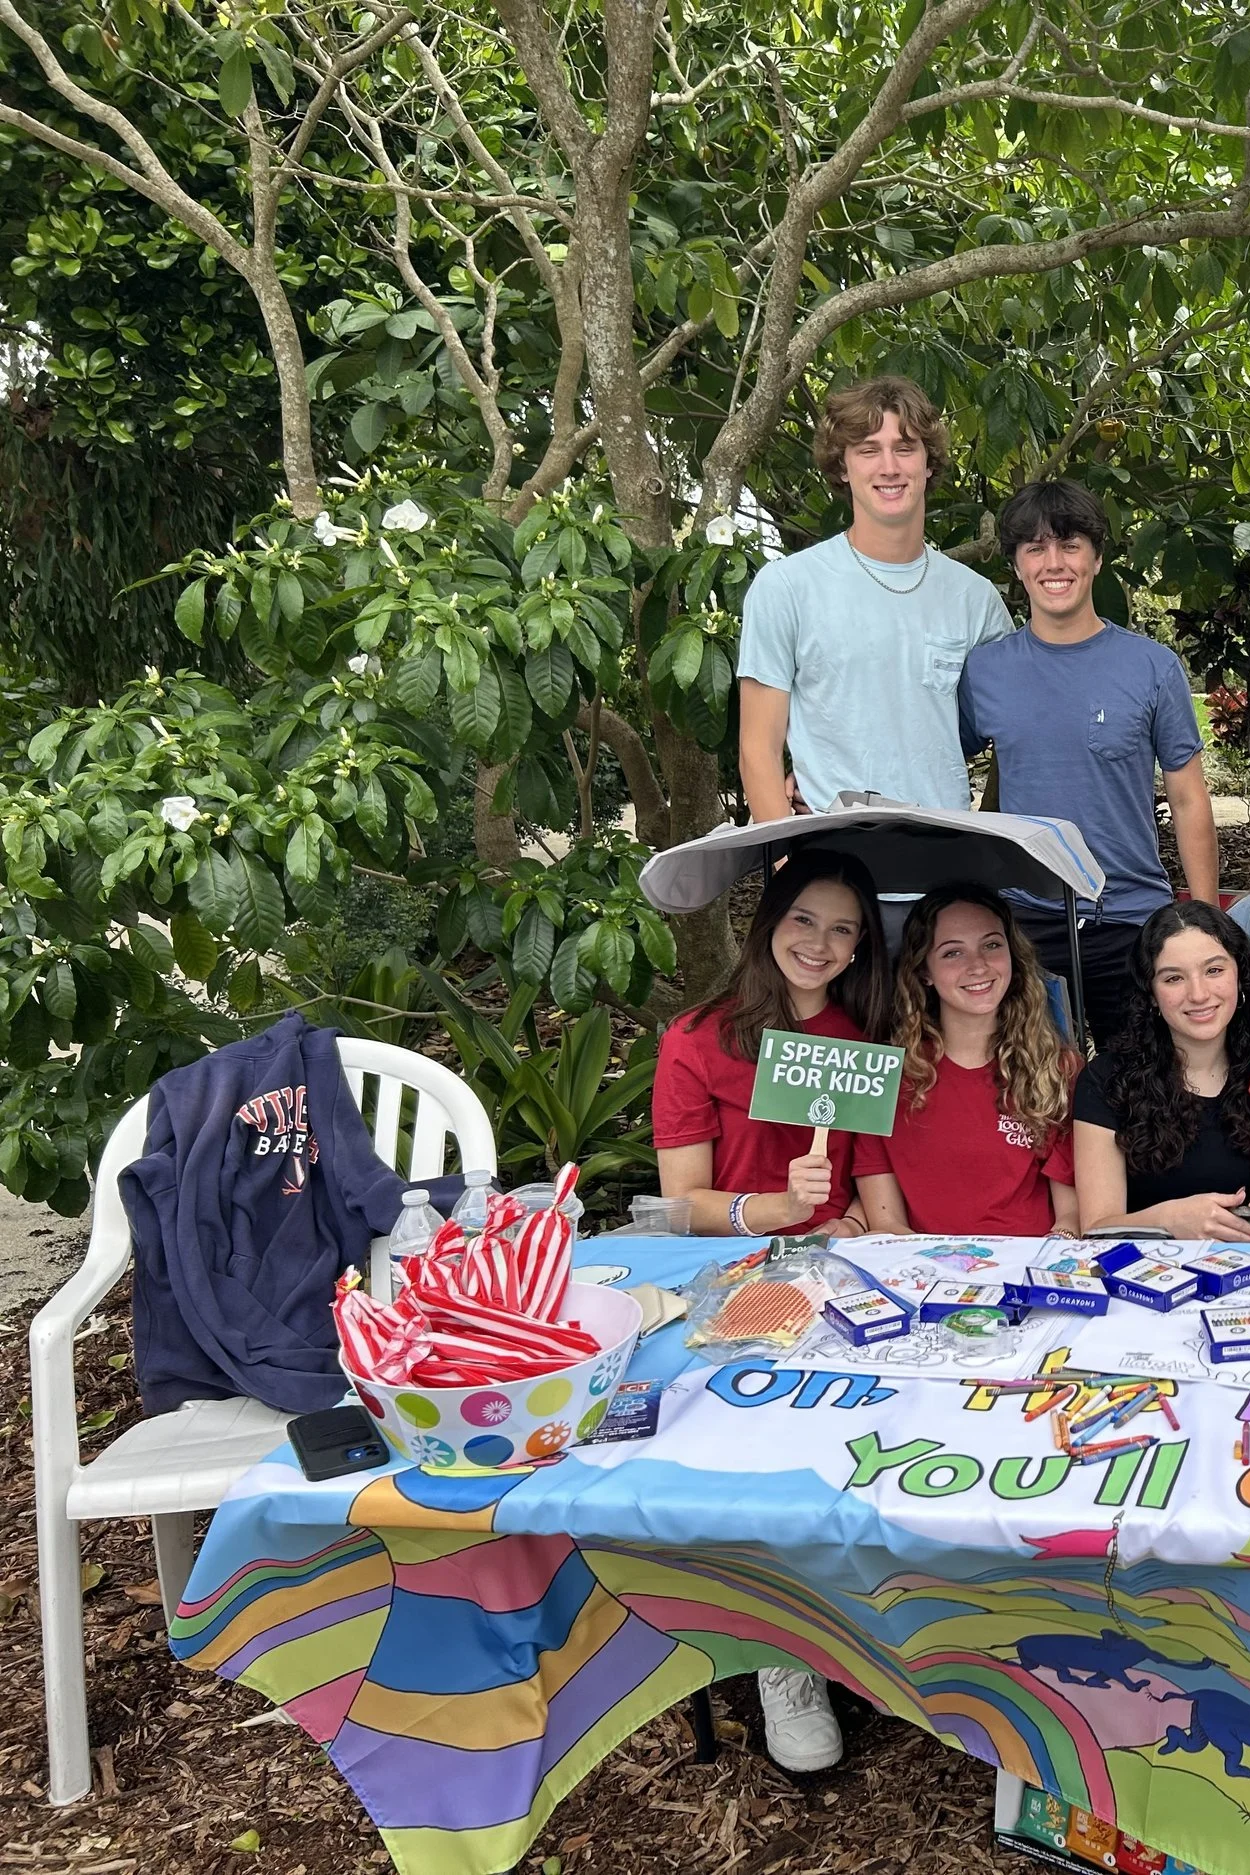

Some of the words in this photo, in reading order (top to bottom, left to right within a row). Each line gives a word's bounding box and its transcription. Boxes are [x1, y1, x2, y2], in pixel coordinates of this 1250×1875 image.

[764, 1038, 774, 1059] I
[780, 1041, 860, 1071] SPEAK
[865, 1052, 900, 1075] UP
[772, 1063, 823, 1089] FOR
[829, 1070, 885, 1097] KIDS
[1060, 1296, 1096, 1308] CRAYONS
[843, 1430, 1191, 1510] Youll
